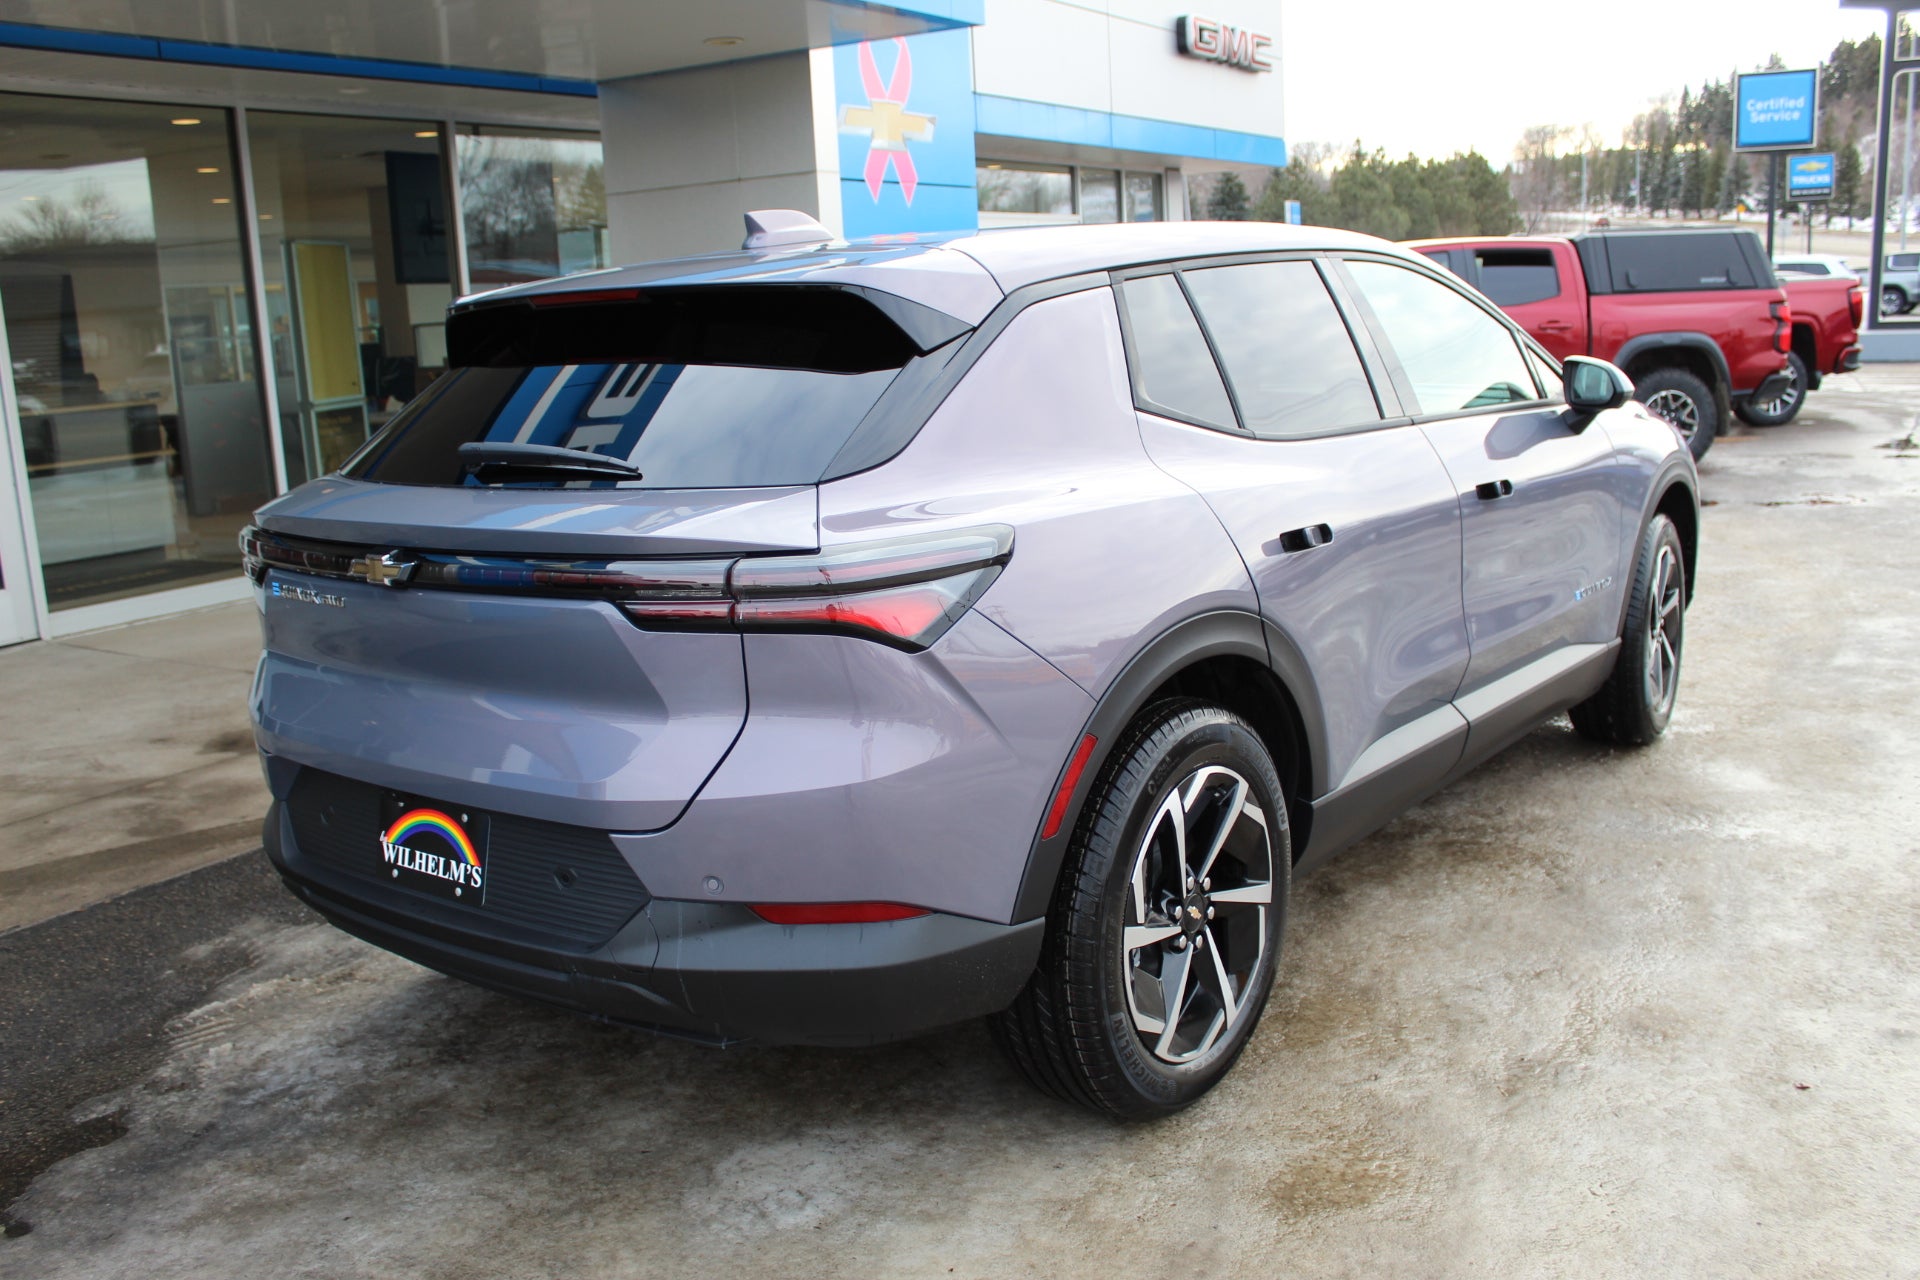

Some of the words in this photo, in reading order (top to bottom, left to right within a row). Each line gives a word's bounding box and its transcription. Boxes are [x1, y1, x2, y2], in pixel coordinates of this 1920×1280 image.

[1183, 15, 1272, 72] GMC
[1746, 96, 1805, 112] Certified
[1750, 110, 1802, 124] Service
[1791, 174, 1831, 186] TRUCKS
[382, 840, 482, 888] WILHELM'S
[1112, 1017, 1160, 1090] MICHELIN
